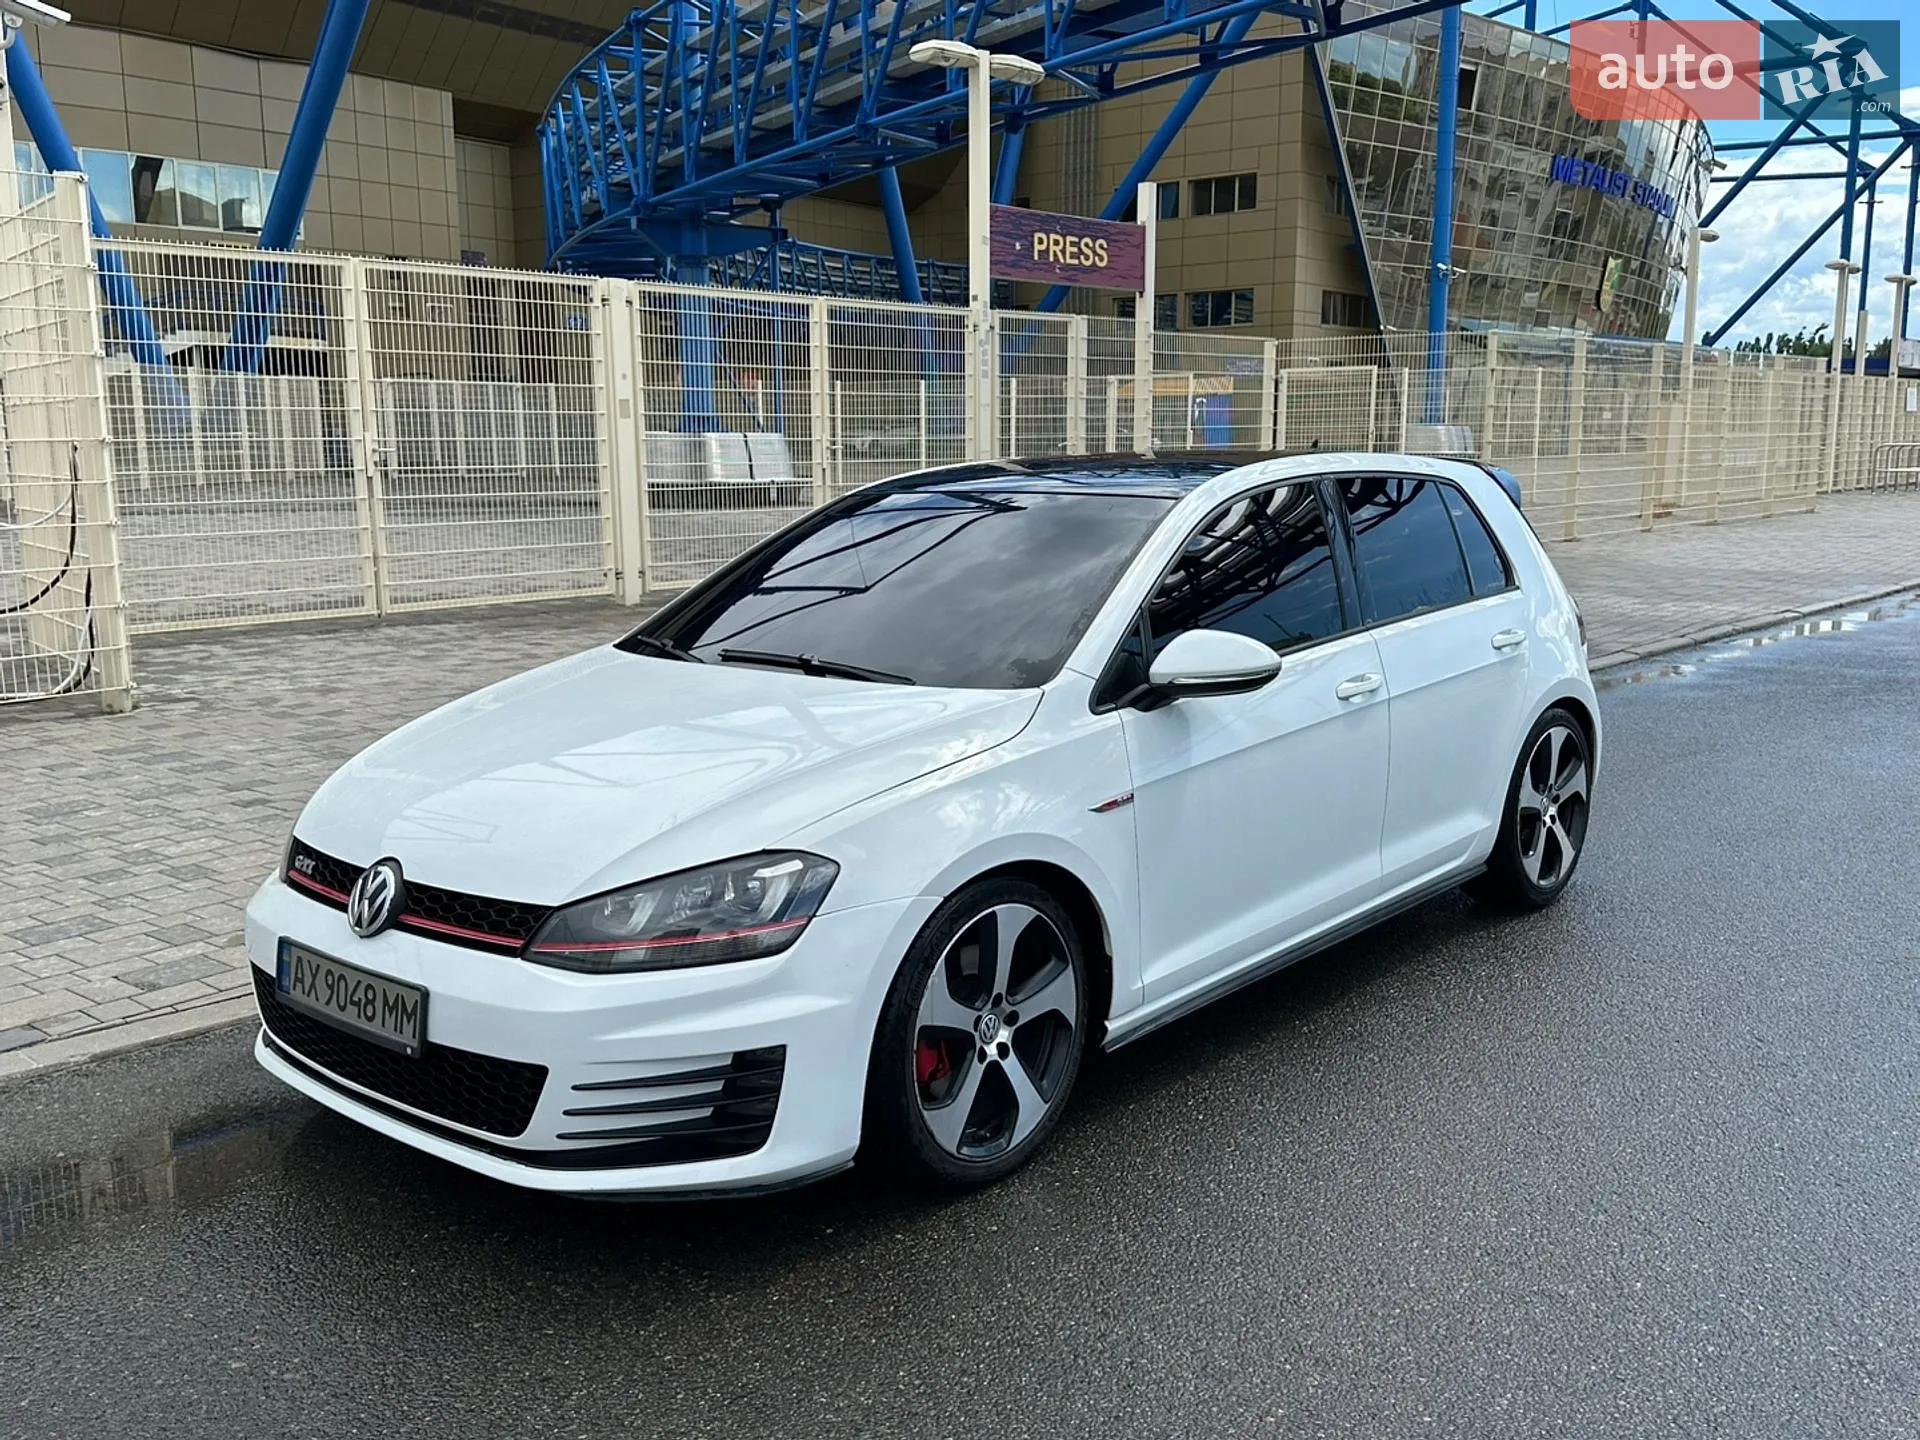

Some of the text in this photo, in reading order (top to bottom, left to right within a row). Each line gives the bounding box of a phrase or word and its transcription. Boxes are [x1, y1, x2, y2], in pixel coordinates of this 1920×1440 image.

[1552, 154, 1632, 198] METALIST
[1033, 231, 1108, 267] PRESS
[292, 956, 320, 1002] AX
[324, 969, 377, 1022] 9048
[382, 988, 418, 1039] MM
